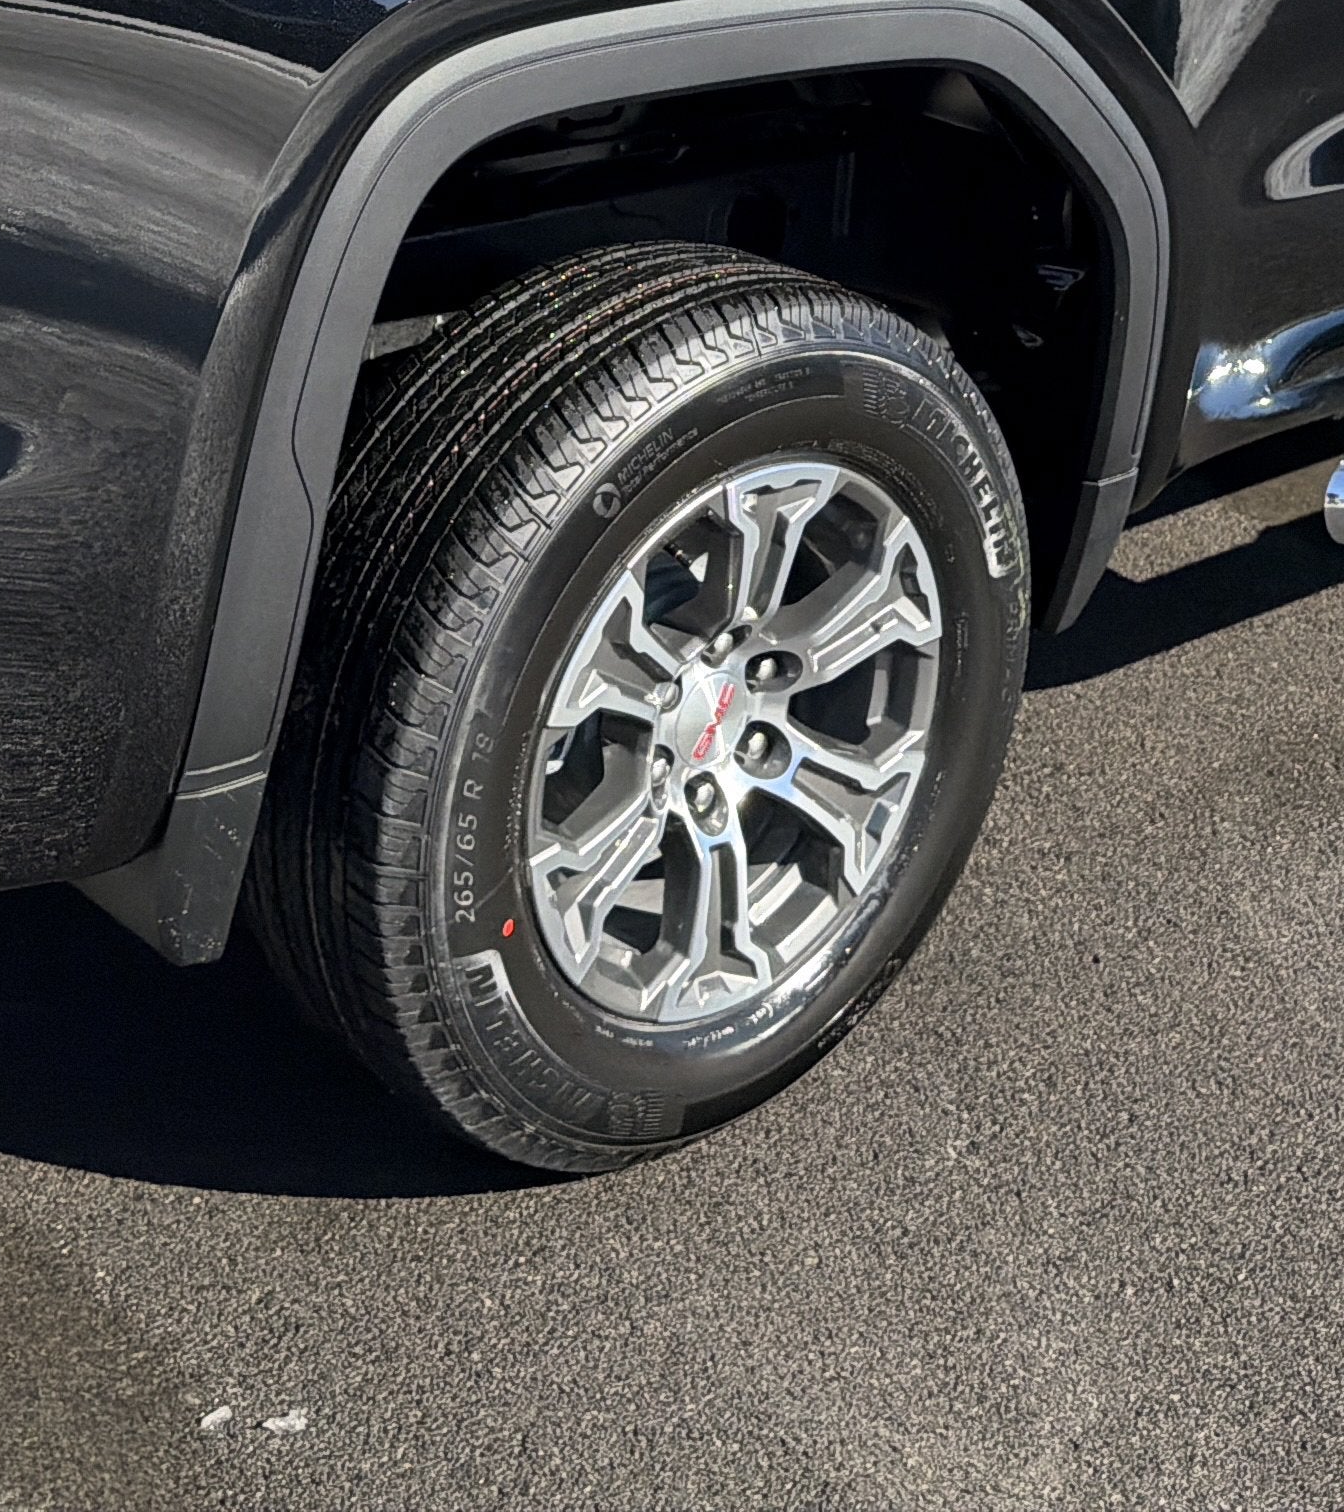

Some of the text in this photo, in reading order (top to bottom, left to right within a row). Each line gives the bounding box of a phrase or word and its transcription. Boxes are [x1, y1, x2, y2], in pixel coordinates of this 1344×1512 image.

[618, 428, 674, 485] MICHELIN
[692, 681, 736, 760] GMC
[454, 732, 494, 923] 265/65 R 18
